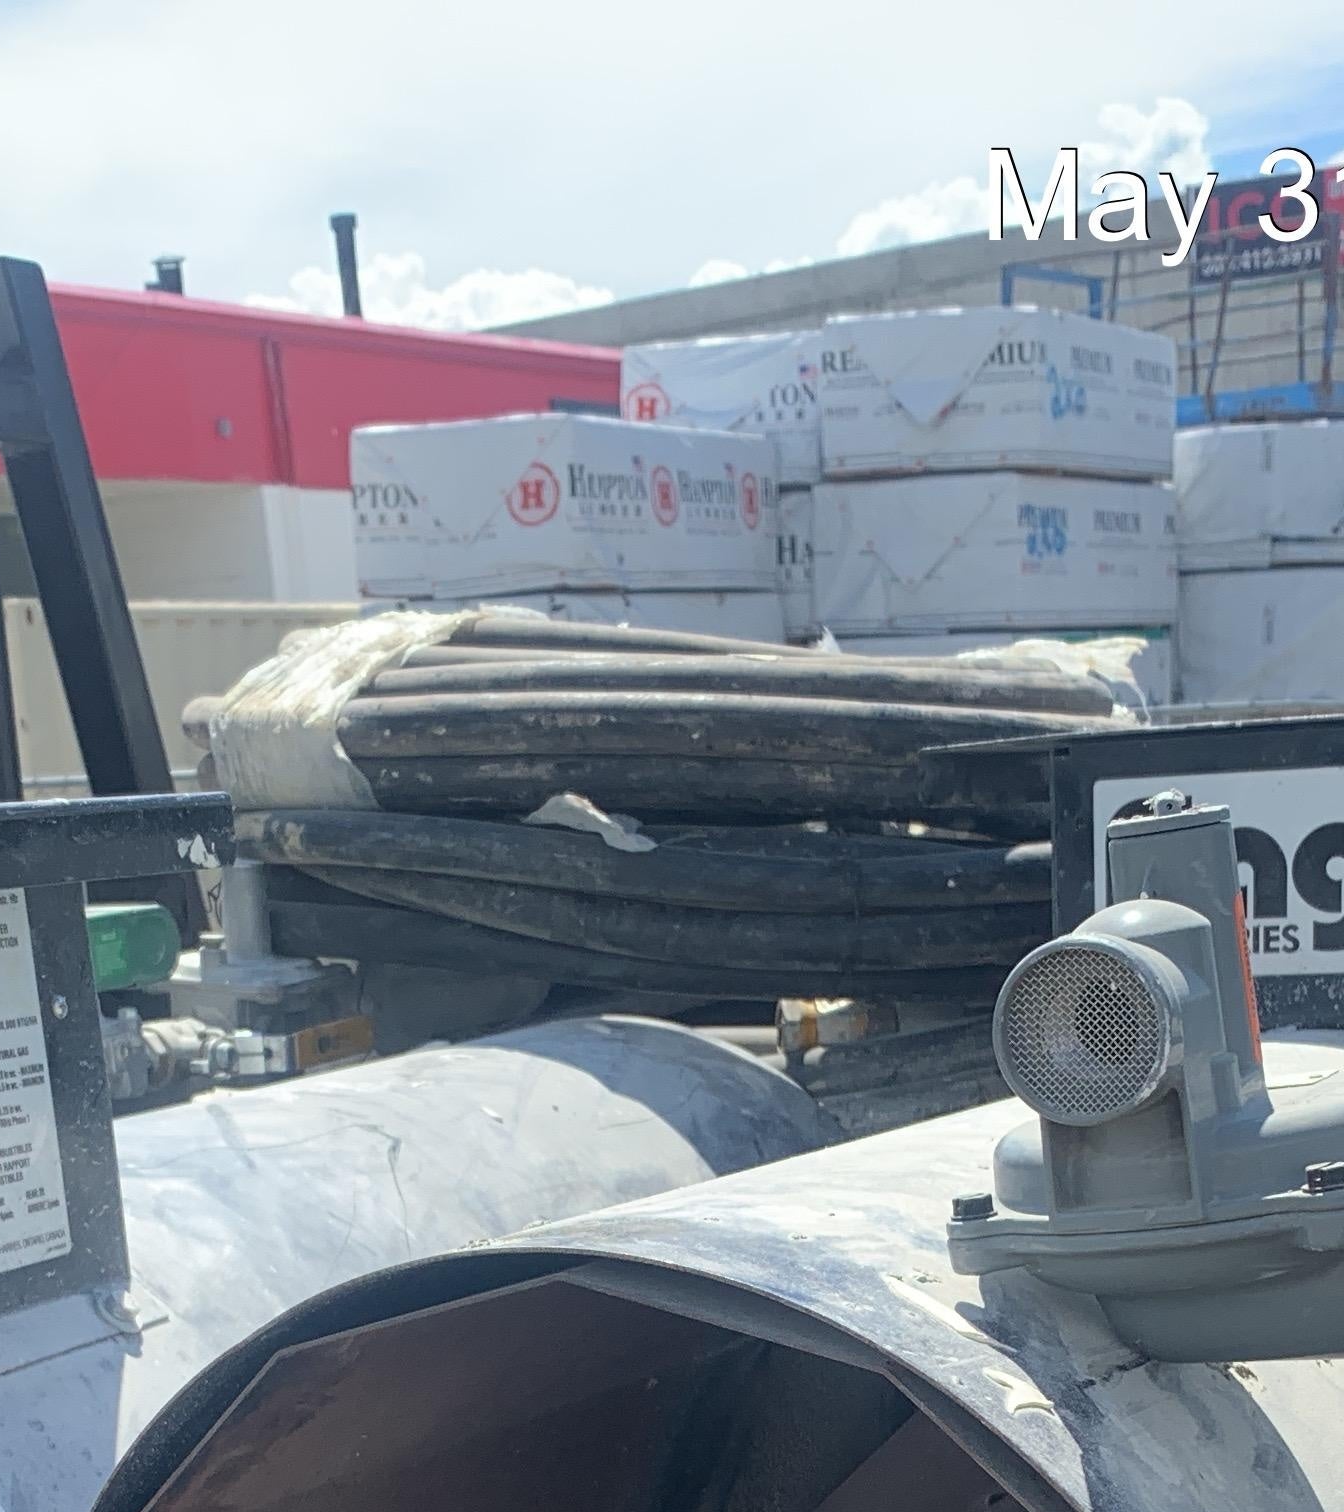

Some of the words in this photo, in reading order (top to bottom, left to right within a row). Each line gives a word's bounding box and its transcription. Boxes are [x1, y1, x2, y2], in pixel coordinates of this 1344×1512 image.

[352, 484, 420, 508] PTON
[14, 1047, 29, 1057] GAS
[3, 1157, 30, 1171] RAPPORT
[44, 1228, 65, 1241] CANADA
